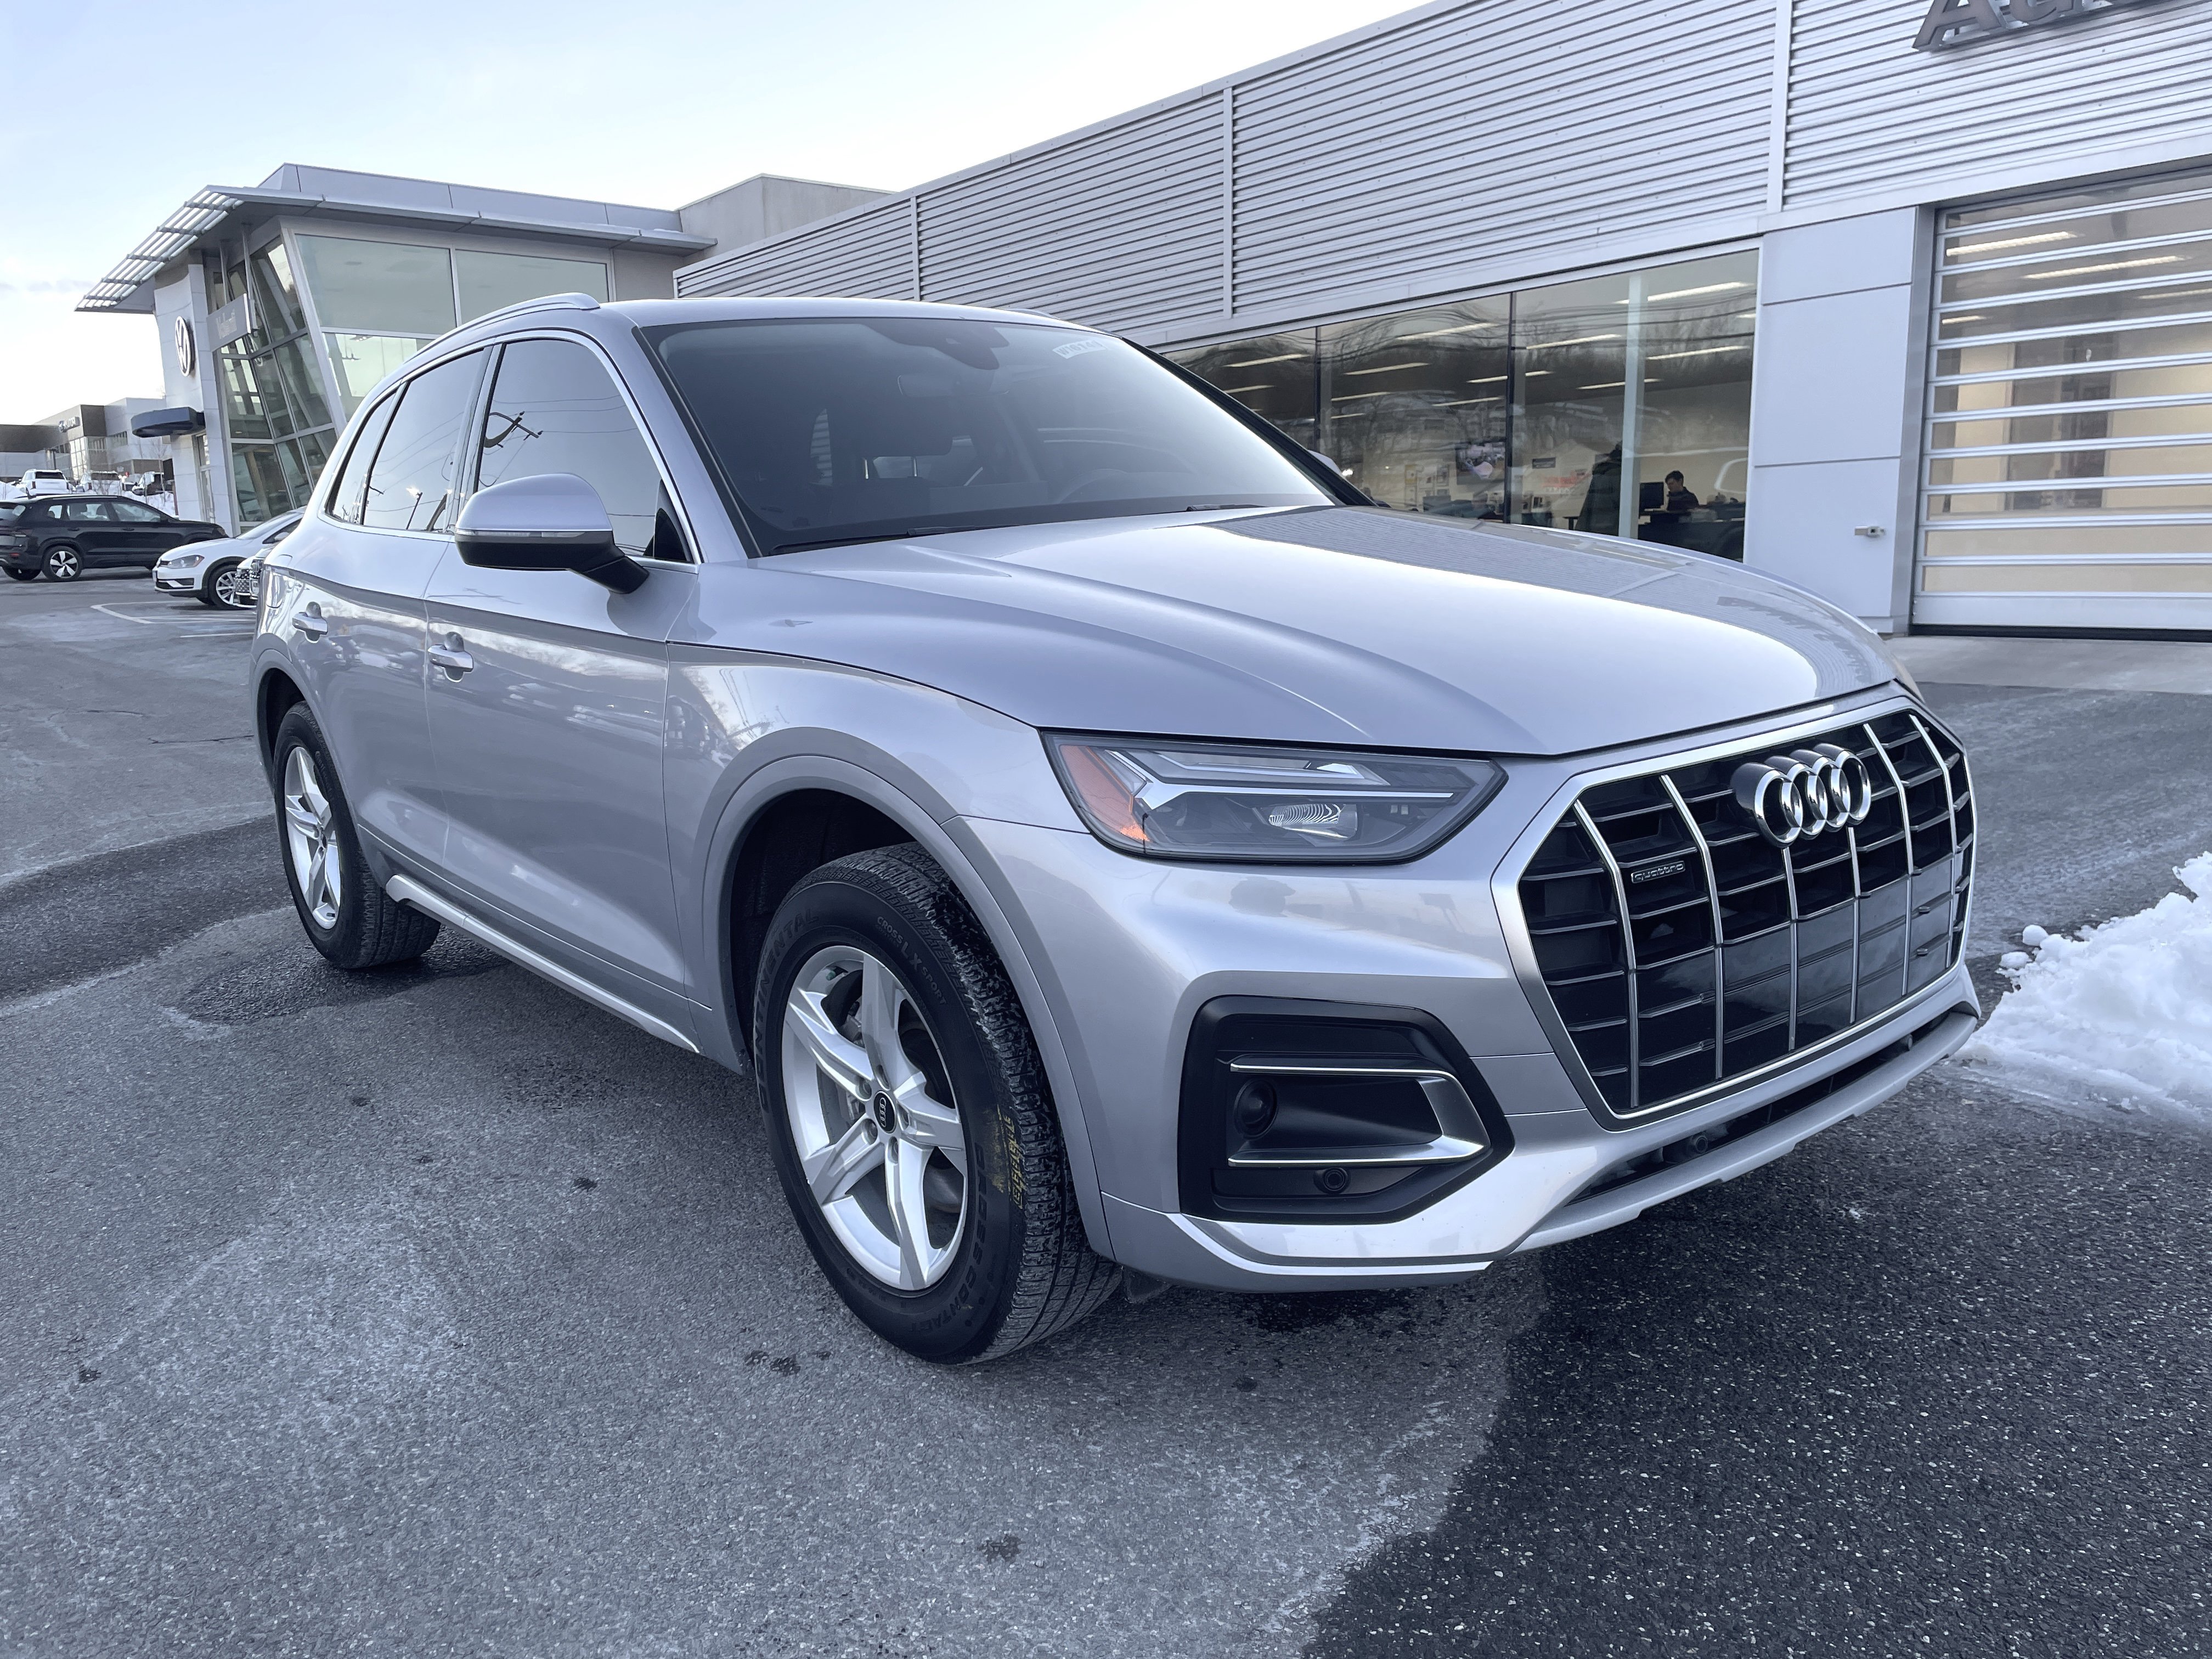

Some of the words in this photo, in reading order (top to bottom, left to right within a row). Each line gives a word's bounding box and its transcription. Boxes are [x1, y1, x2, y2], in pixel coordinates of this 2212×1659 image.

[1634, 863, 1684, 881] quattro
[877, 916, 904, 944] CROSS
[922, 967, 947, 1005] SPORT
[755, 909, 820, 1114] CONTINENTAL
